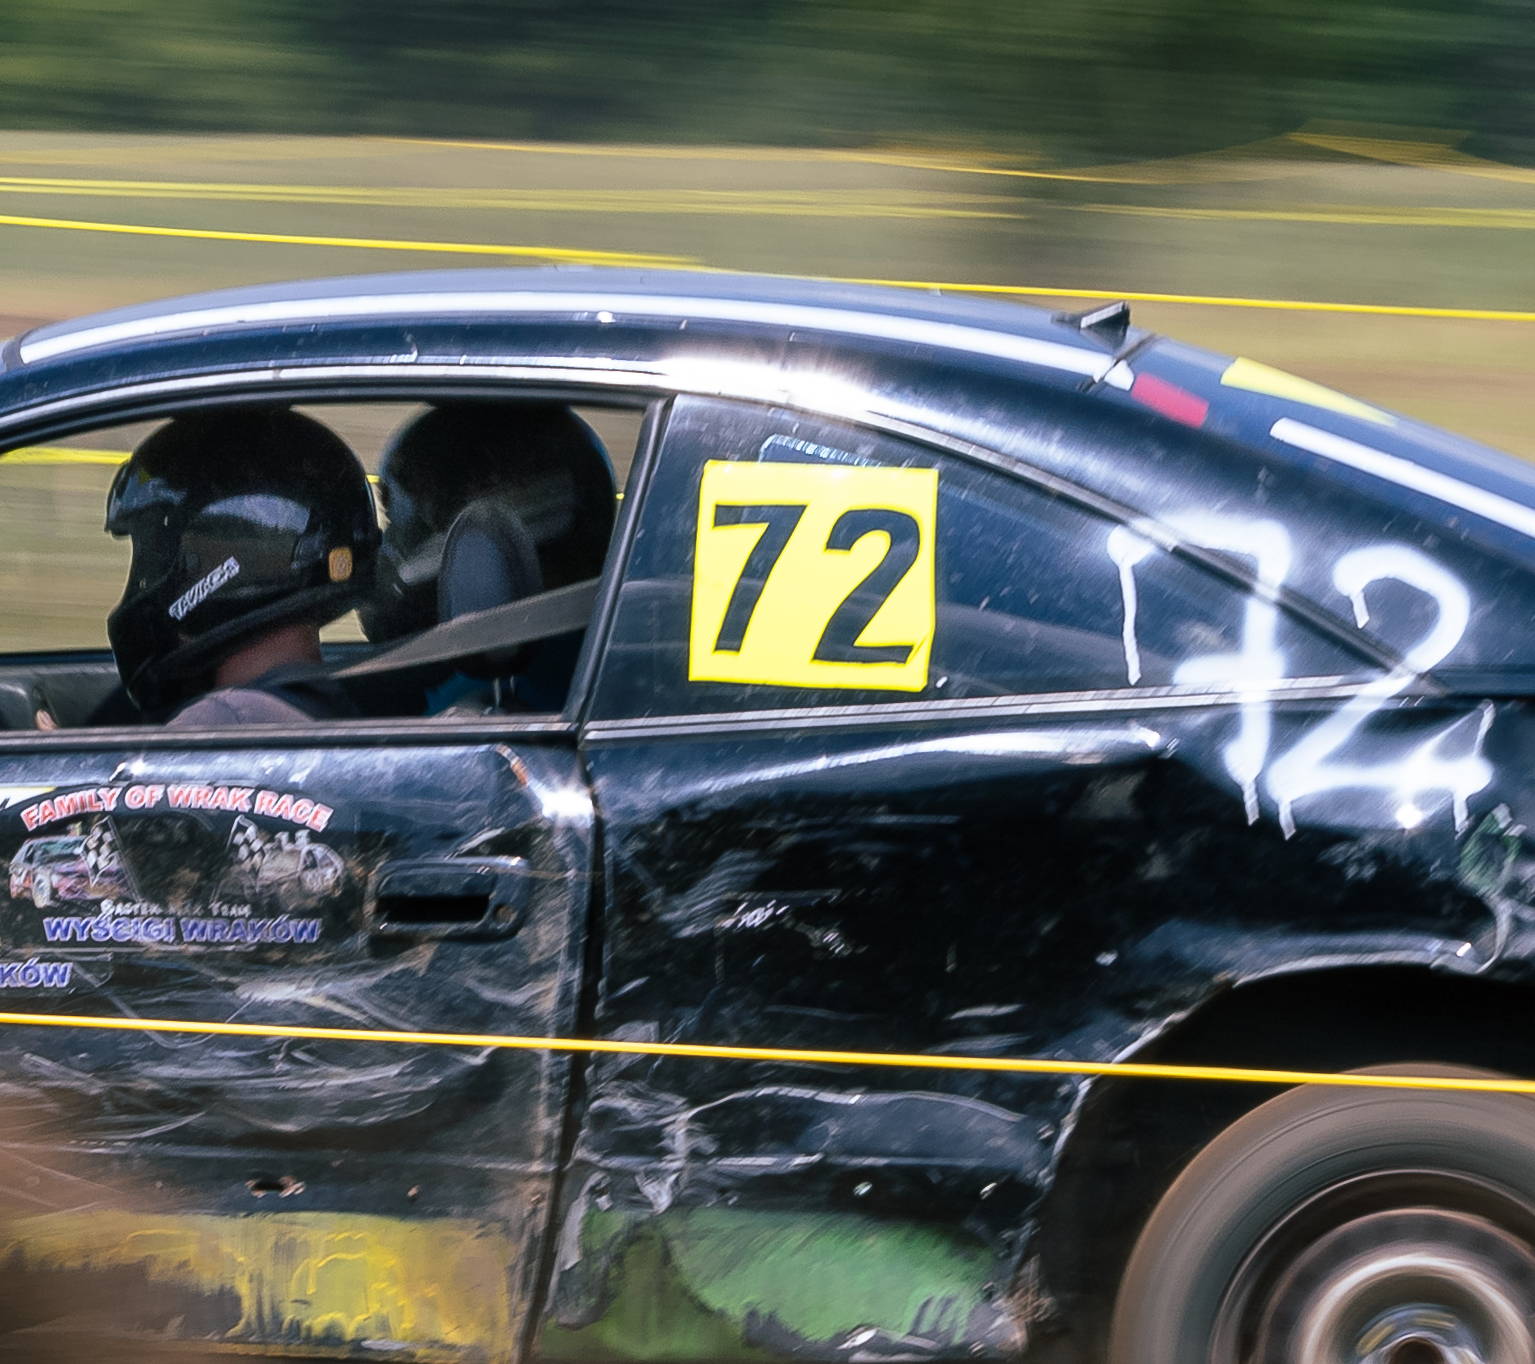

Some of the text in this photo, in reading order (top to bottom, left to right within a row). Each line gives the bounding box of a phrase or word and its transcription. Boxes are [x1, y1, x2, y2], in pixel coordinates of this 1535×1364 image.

[711, 502, 922, 666] 72
[1106, 509, 1493, 838] 72
[20, 784, 335, 833] FAMILY OF WRAK RACE
[42, 908, 177, 944] WYŚCIGI
[179, 913, 324, 944] WRAKÓW
